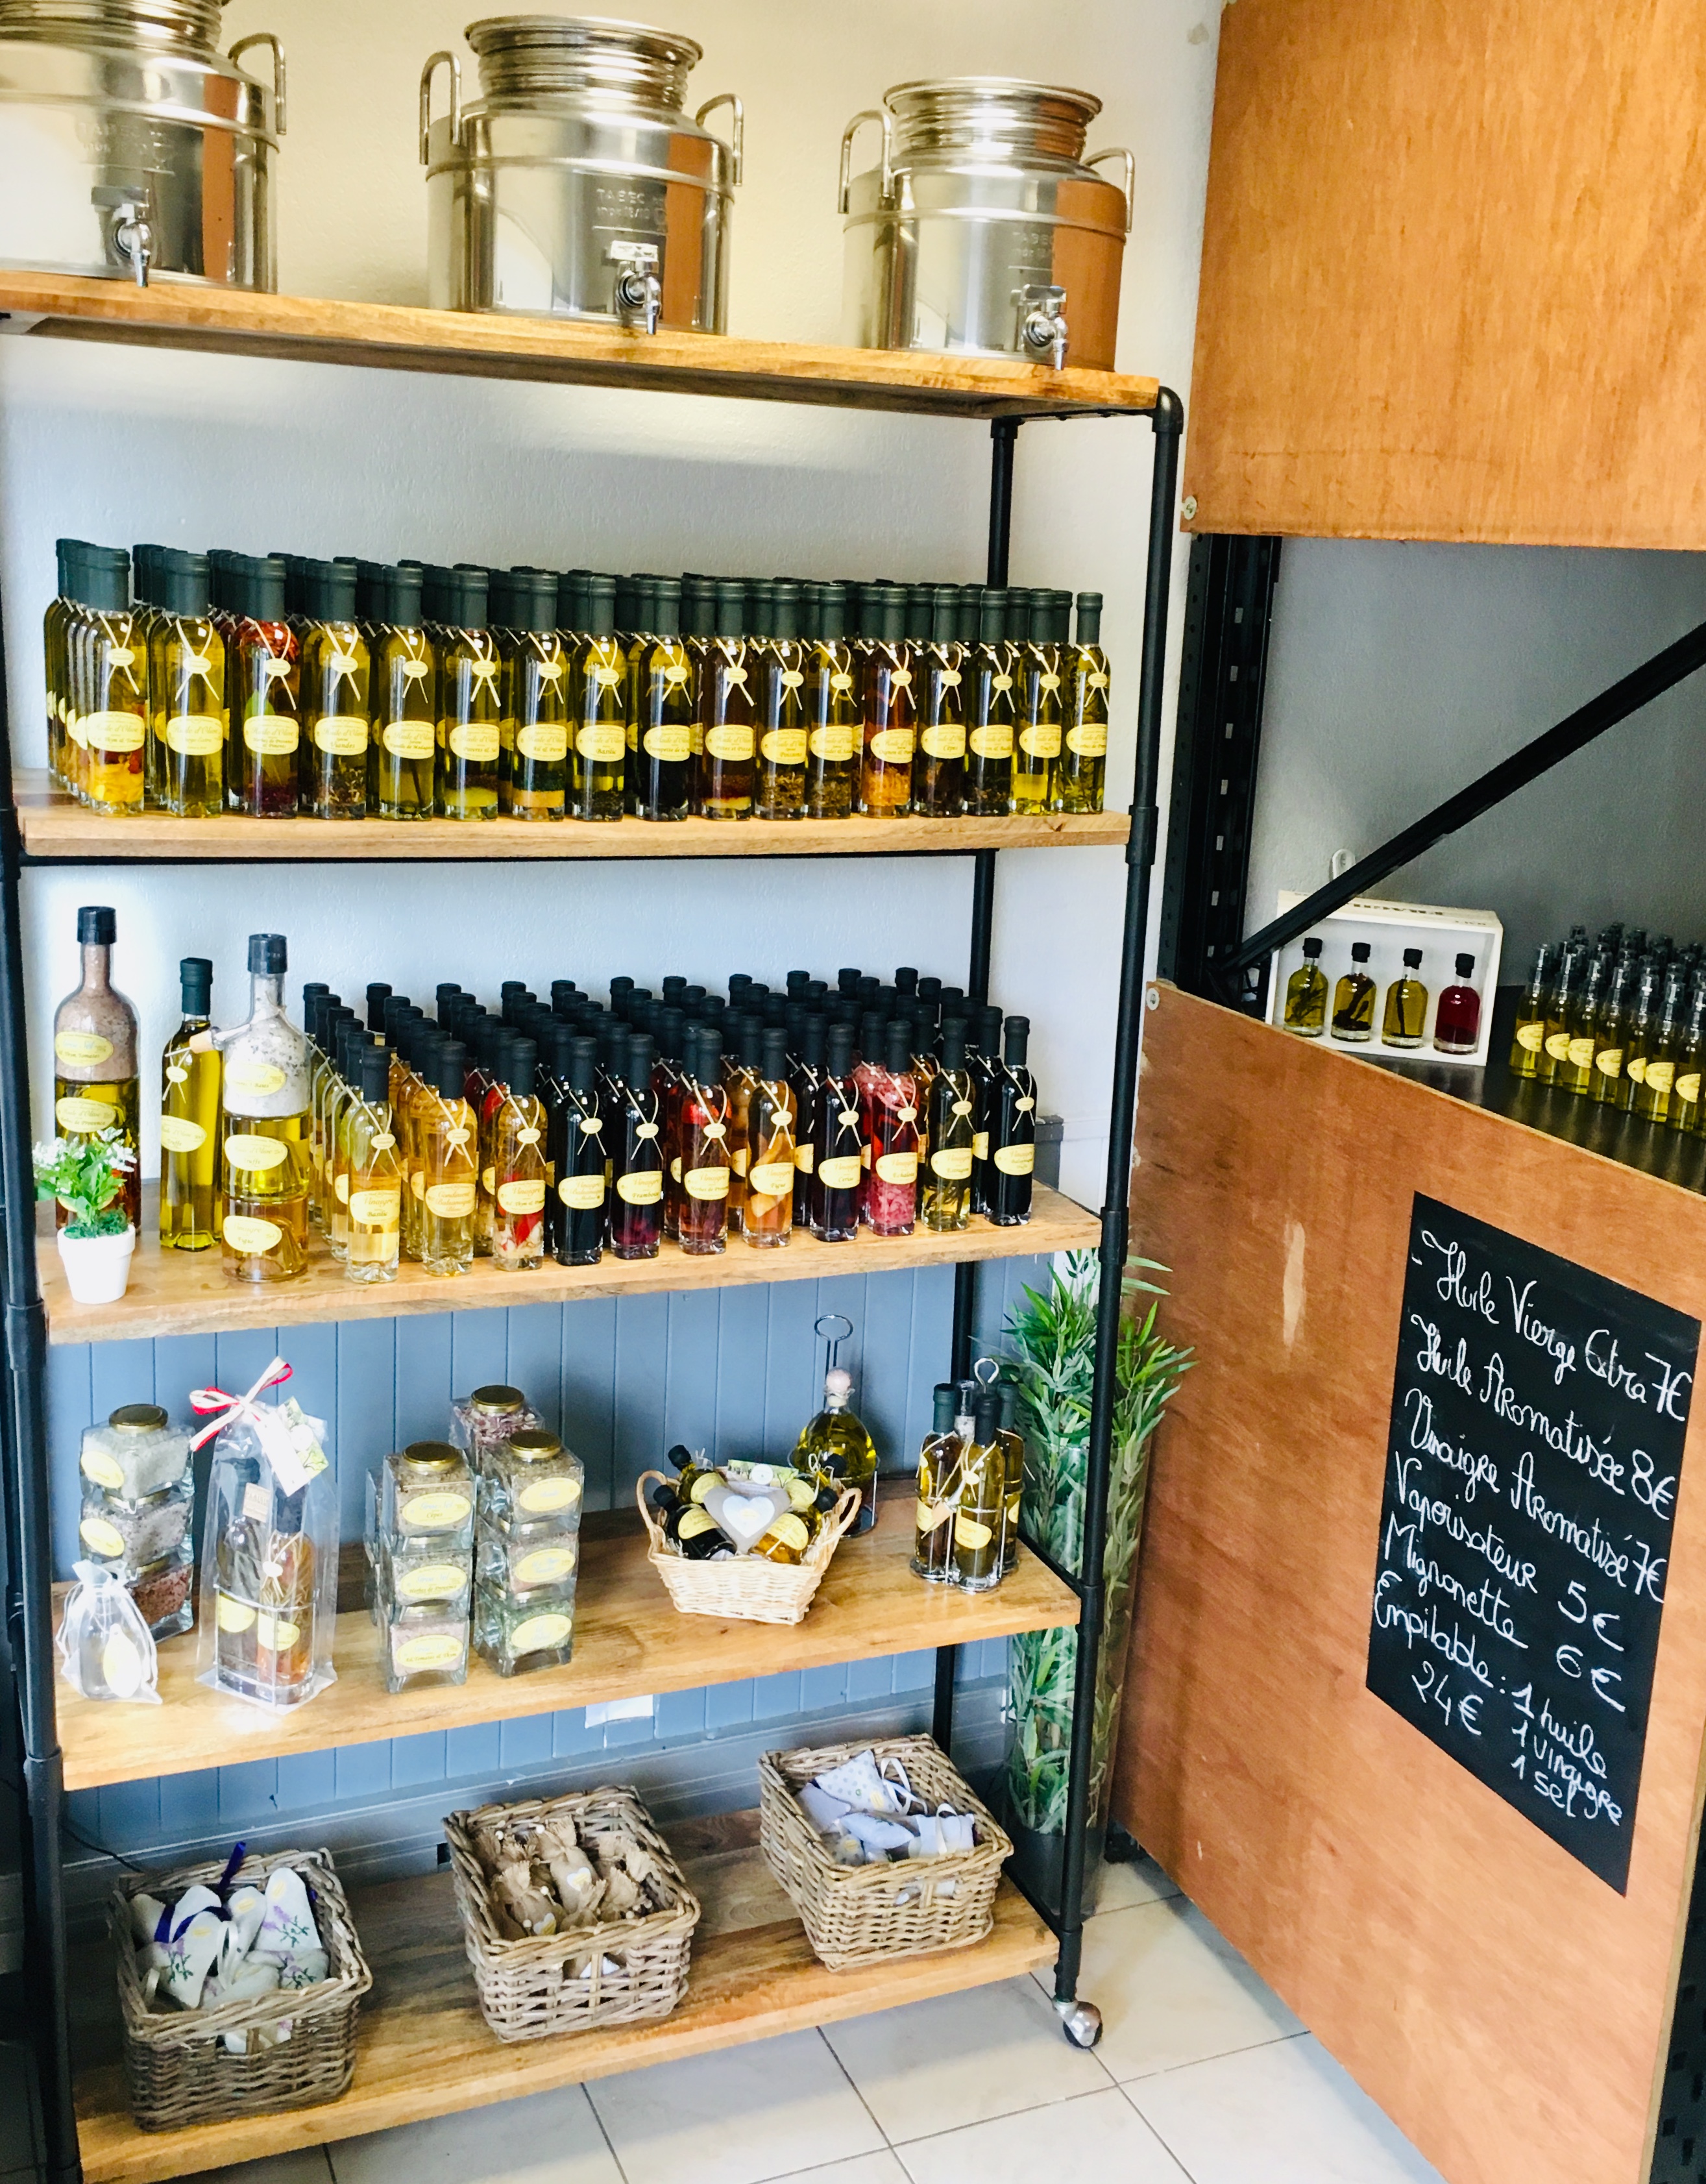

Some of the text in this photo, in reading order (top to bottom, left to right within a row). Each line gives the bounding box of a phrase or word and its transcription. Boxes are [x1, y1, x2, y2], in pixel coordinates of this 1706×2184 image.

[1422, 1230, 1500, 1324] Huile
[1505, 1275, 1577, 1385] Vierge
[1585, 1329, 1648, 1404] Extra
[1645, 1351, 1693, 1422] 7€
[1410, 1314, 1472, 1395] Huile
[1631, 1449, 1676, 1520] 8€
[1633, 1541, 1667, 1604] 7€
[1411, 1660, 1484, 1737] 24€
[1540, 1697, 1608, 1780] huile
